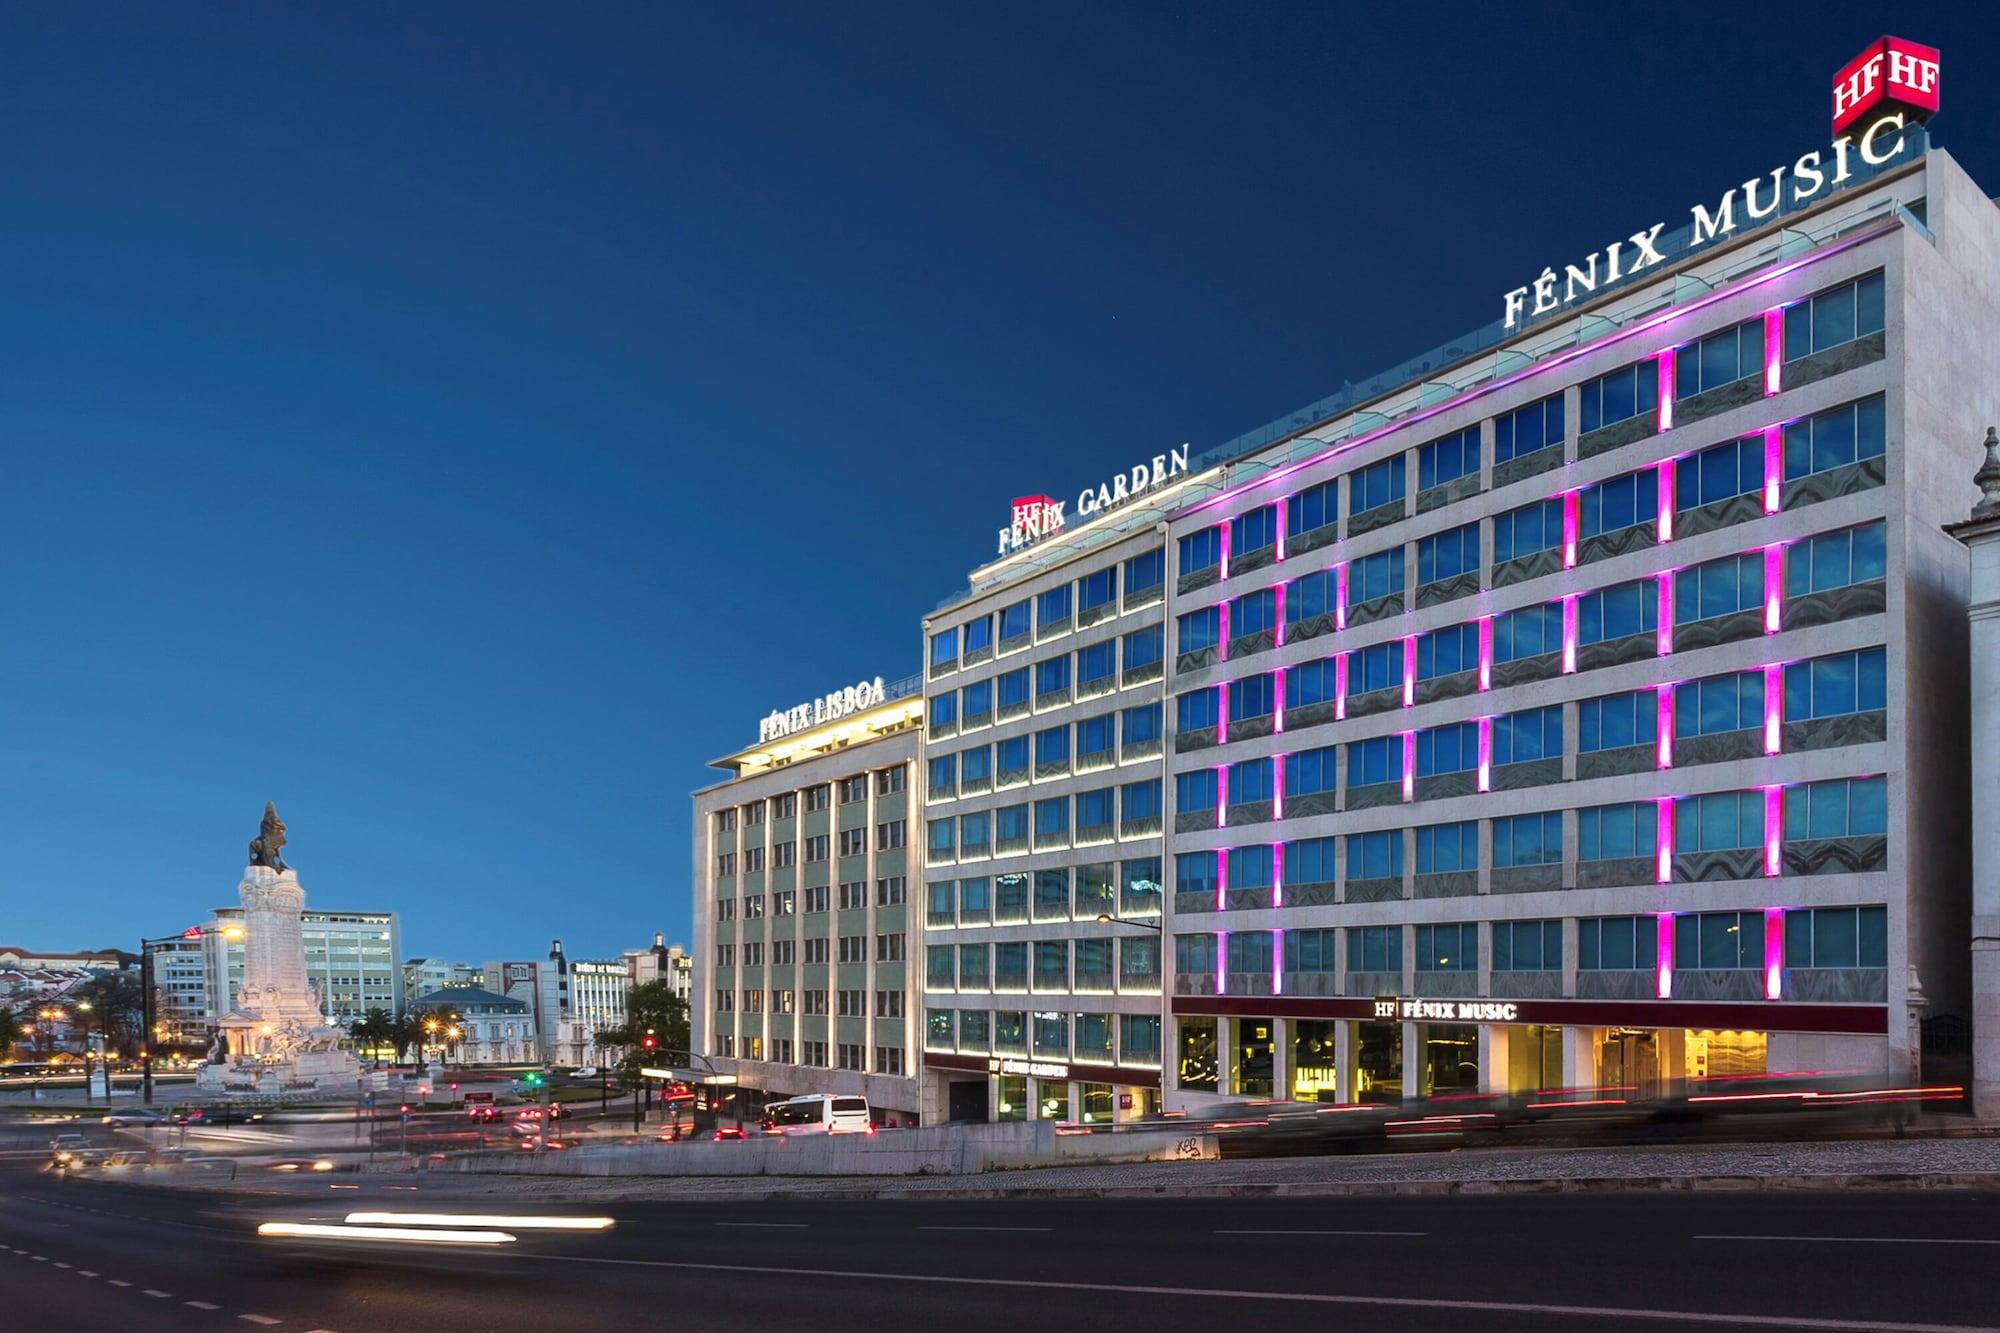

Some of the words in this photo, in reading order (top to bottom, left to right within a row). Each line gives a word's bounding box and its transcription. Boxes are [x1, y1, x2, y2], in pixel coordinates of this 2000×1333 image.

[1833, 53, 1884, 120] HF
[1888, 50, 1940, 93] HF
[1503, 222, 1667, 328] FÉNIX
[1690, 112, 1905, 248] MUSIC
[1078, 443, 1190, 516] GARDEN
[760, 702, 810, 743] FÉNIX
[814, 676, 885, 725] LISBOA
[1375, 1002, 1395, 1017] HF
[1403, 999, 1455, 1018] FÉNIX
[1458, 1003, 1517, 1020] MUSIC
